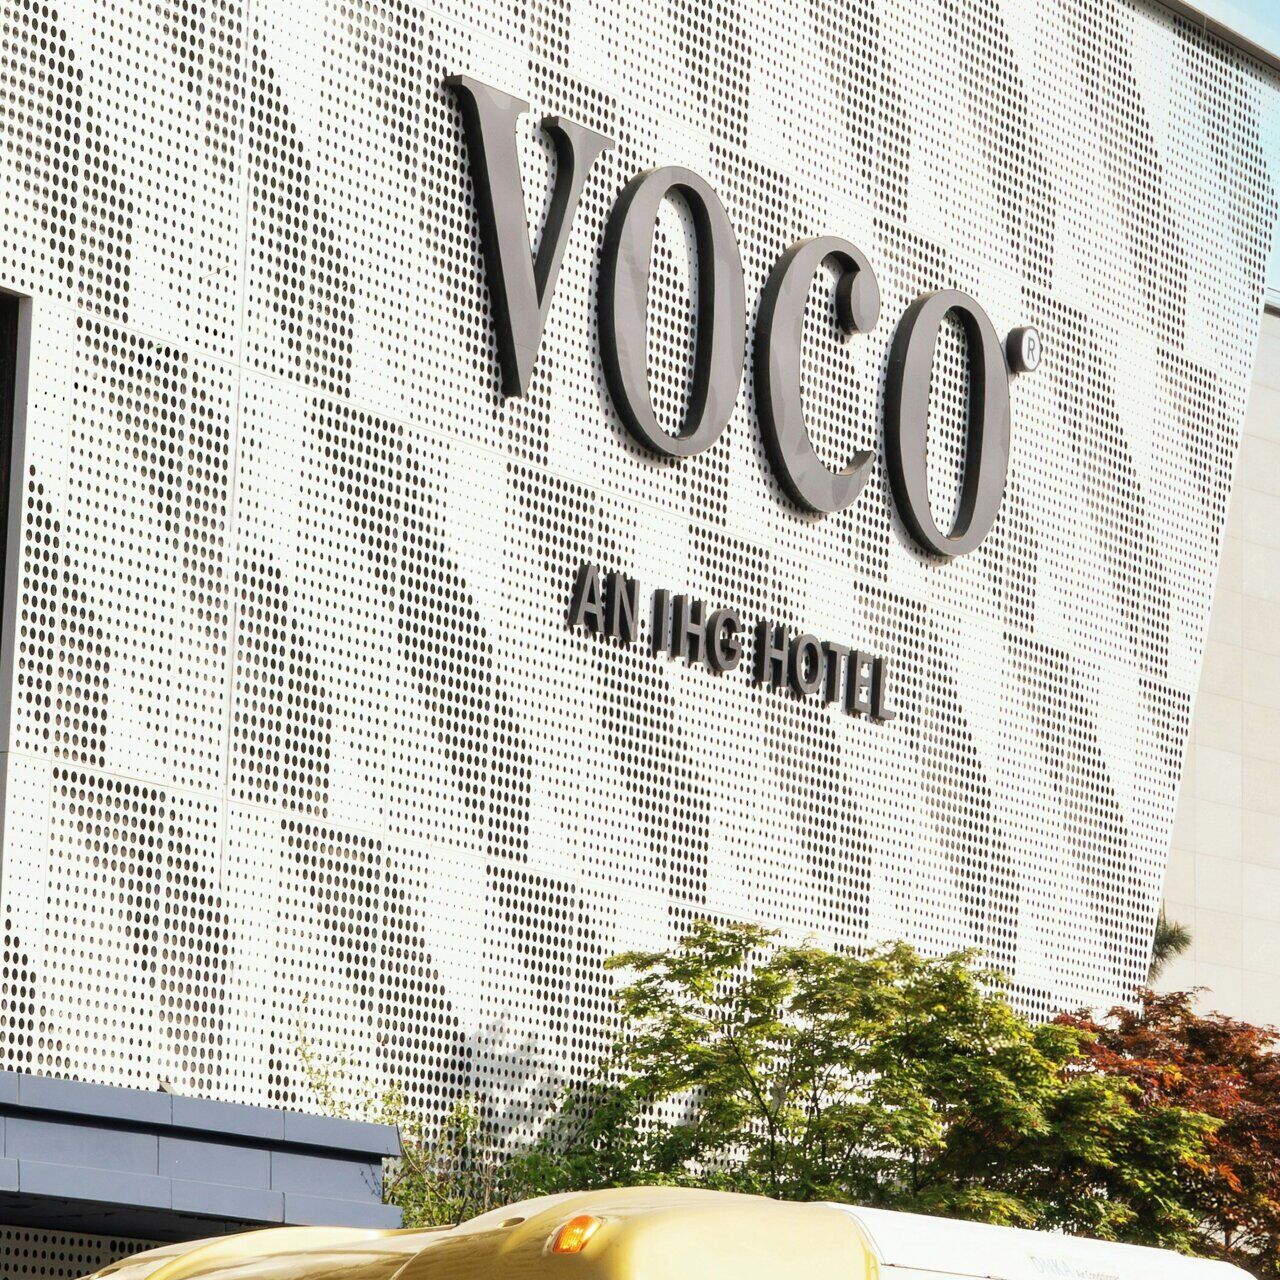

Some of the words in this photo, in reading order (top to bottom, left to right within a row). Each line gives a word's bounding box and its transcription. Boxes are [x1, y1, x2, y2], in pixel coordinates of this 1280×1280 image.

[568, 564, 640, 643] AN
[650, 588, 742, 672] IHG
[753, 620, 895, 724] HOTEL
